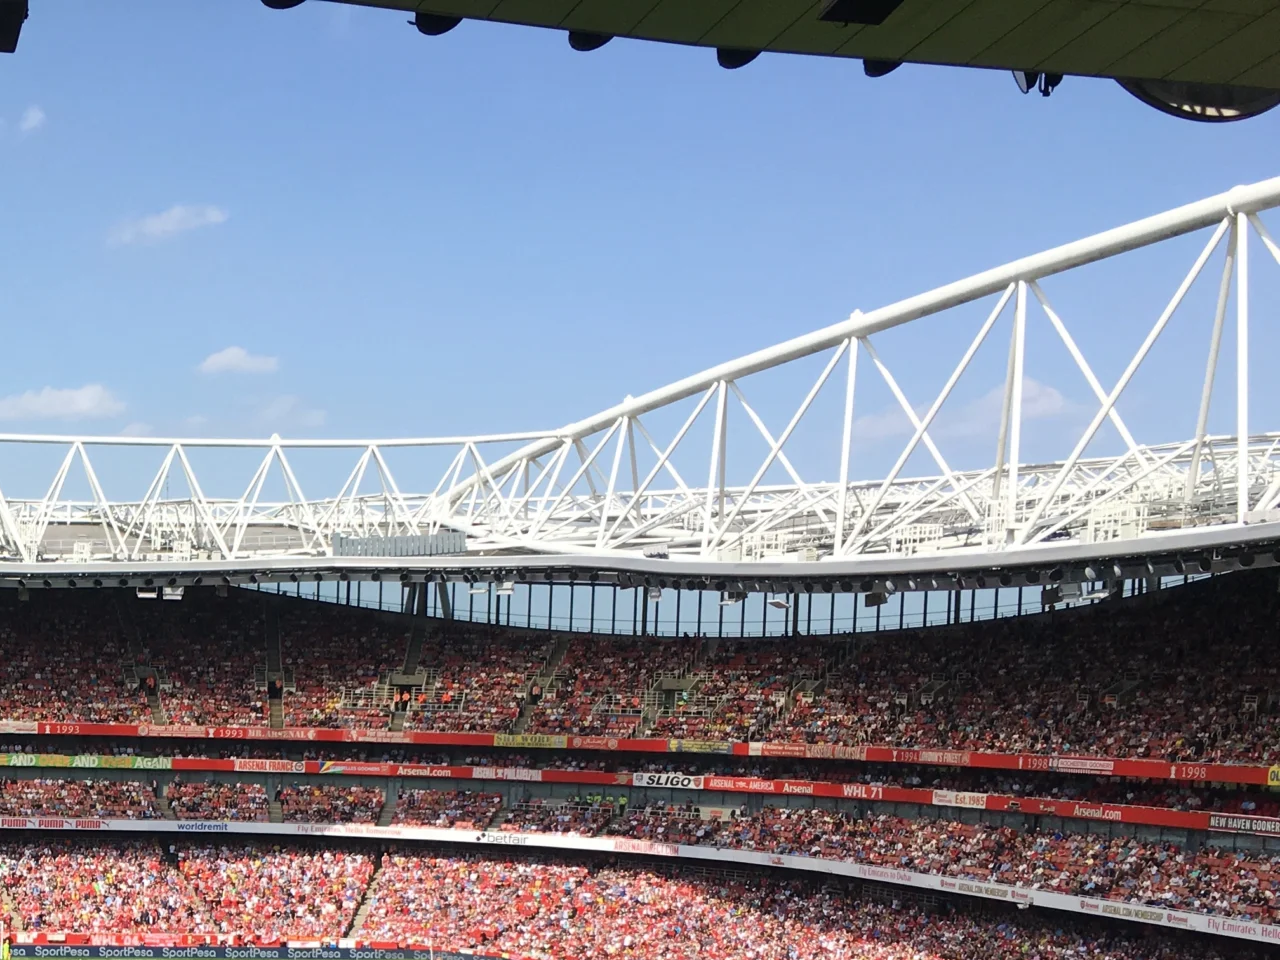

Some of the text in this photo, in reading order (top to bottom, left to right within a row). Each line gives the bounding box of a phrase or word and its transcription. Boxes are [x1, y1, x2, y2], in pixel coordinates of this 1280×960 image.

[56, 726, 80, 734] 1993
[220, 729, 243, 738] 1993
[265, 730, 306, 739] ARSENAL
[10, 756, 36, 766] AND
[72, 756, 98, 767] AND
[134, 757, 172, 768] AGAIN
[900, 752, 918, 761] 1994
[238, 761, 294, 772] ARSENAL FRANCE
[1028, 758, 1048, 769] 1998
[396, 767, 452, 777] Arsenal.com
[472, 768, 496, 779] ARSENAL
[1182, 766, 1206, 778] 1998
[646, 775, 692, 788] SLIGO
[710, 779, 774, 792] ARSENAL AMERICA
[782, 783, 813, 794] Arsenal
[843, 785, 883, 799] WHL 71
[968, 796, 985, 806] 1985
[1073, 804, 1122, 820] Arsenal.com
[2, 818, 27, 828] PUMA
[38, 819, 64, 828] PUMA
[76, 820, 100, 828] PUMA
[177, 822, 228, 831] worldremit
[297, 824, 308, 833] Fly
[1210, 816, 1280, 832] NEW HAVEN GOONER
[487, 833, 528, 844] betfair
[858, 866, 867, 876] Fly
[868, 867, 890, 878] Emirates
[1208, 918, 1220, 931] Fly
[90, 934, 116, 944] WHL
[34, 946, 90, 957] SportPesa
[98, 946, 154, 958] SportPesa
[162, 947, 216, 958] SportPesa
[224, 948, 279, 958] SportPesa
[288, 948, 340, 960] SportPesa
[349, 949, 404, 960] SportPesa
